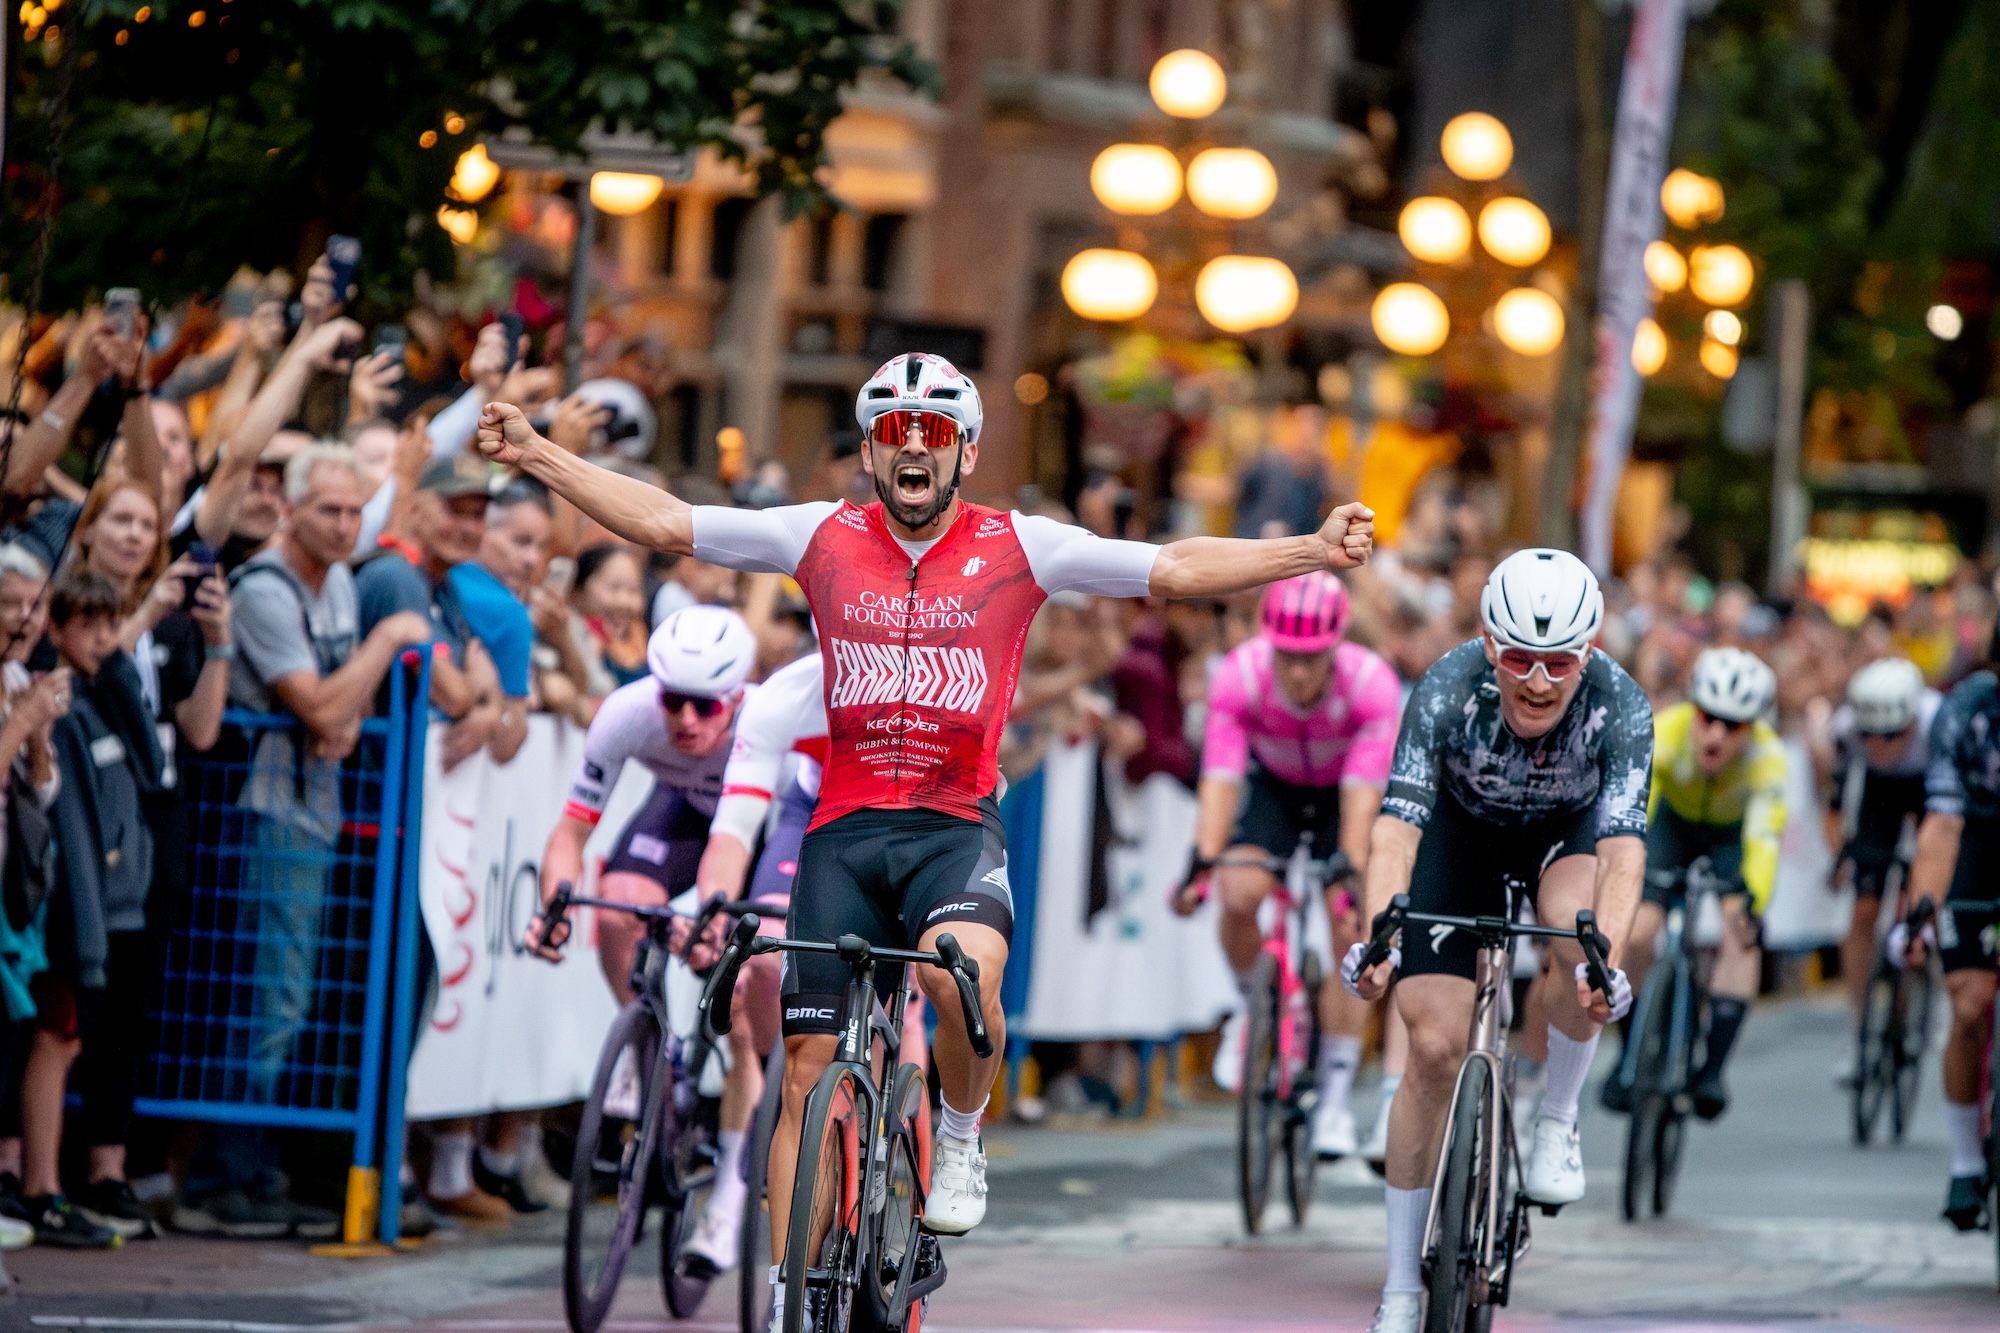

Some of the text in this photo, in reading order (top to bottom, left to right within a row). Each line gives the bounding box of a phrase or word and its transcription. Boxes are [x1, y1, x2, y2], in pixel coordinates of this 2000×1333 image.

[834, 514, 868, 532] Partners
[842, 510, 866, 525] Equity
[980, 520, 1004, 532] Equity
[974, 526, 1010, 538] Partners
[860, 590, 962, 614] CAROLAN
[843, 603, 978, 628] FOUNDATION
[830, 636, 989, 715] FOUNDATION
[866, 717, 940, 734] KEMPNER
[855, 738, 889, 751] DUBIN
[901, 738, 950, 754] COMPANY
[906, 752, 944, 765] PARTNERS
[926, 902, 979, 921] BMC
[786, 1008, 835, 1020] BMC
[845, 1018, 858, 1053] BMC
